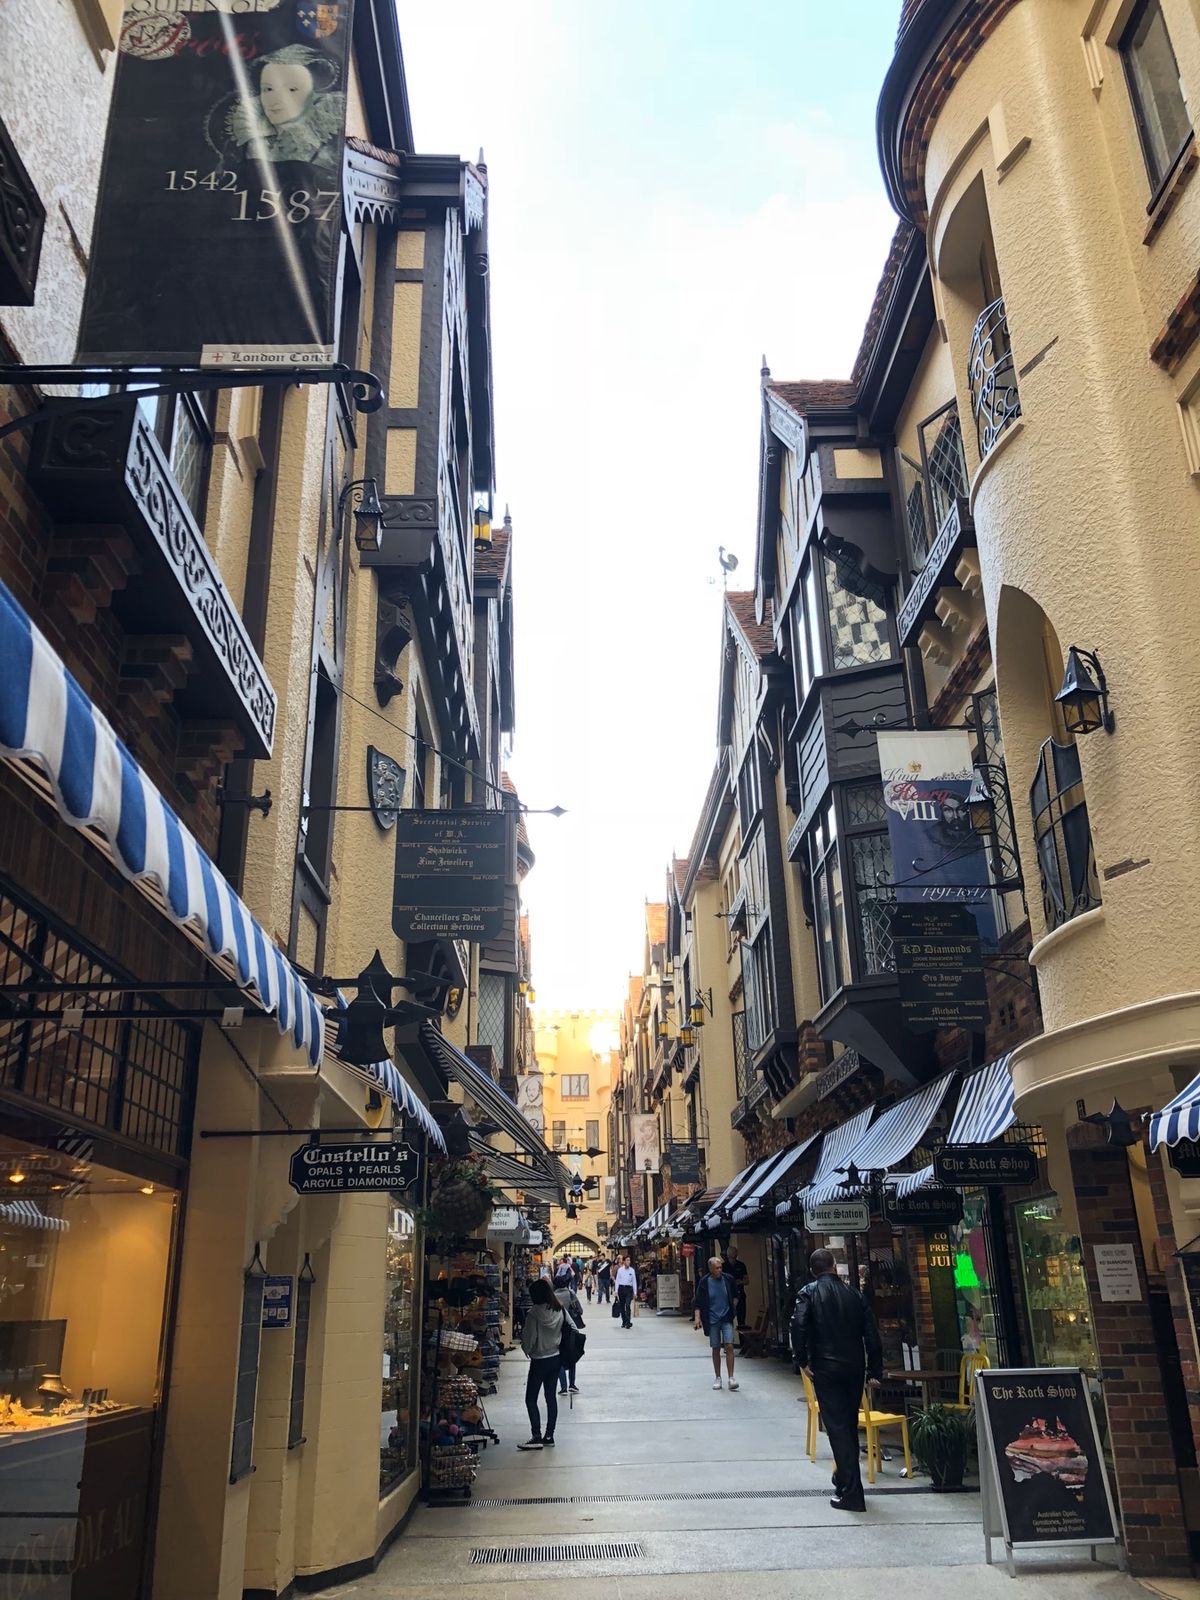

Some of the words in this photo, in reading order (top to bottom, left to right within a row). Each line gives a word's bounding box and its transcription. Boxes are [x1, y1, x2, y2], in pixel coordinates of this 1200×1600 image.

[164, 169, 238, 191] 1542
[230, 190, 340, 223] 1587
[230, 351, 285, 362] London
[883, 766, 919, 782] King
[893, 800, 939, 821] VIII
[409, 922, 448, 931] Collection
[450, 922, 486, 931] Services
[923, 944, 972, 954] Diamonds
[931, 1007, 960, 1015] Michael
[303, 1146, 408, 1164] Costello's
[308, 1166, 343, 1176] OPALS
[359, 1165, 401, 1174] PEARLS
[942, 1157, 964, 1171] The
[967, 1157, 997, 1170] Rock
[1000, 1157, 1030, 1171] Shop
[302, 1178, 344, 1188] ARGYLE
[347, 1177, 406, 1187] DIAMONDS
[810, 1208, 832, 1221] Juice
[833, 1208, 864, 1220] Station
[934, 1232, 947, 1240] CO
[992, 1386, 1014, 1400] The
[1016, 1385, 1044, 1400] Rock
[1046, 1385, 1077, 1400] Shop
